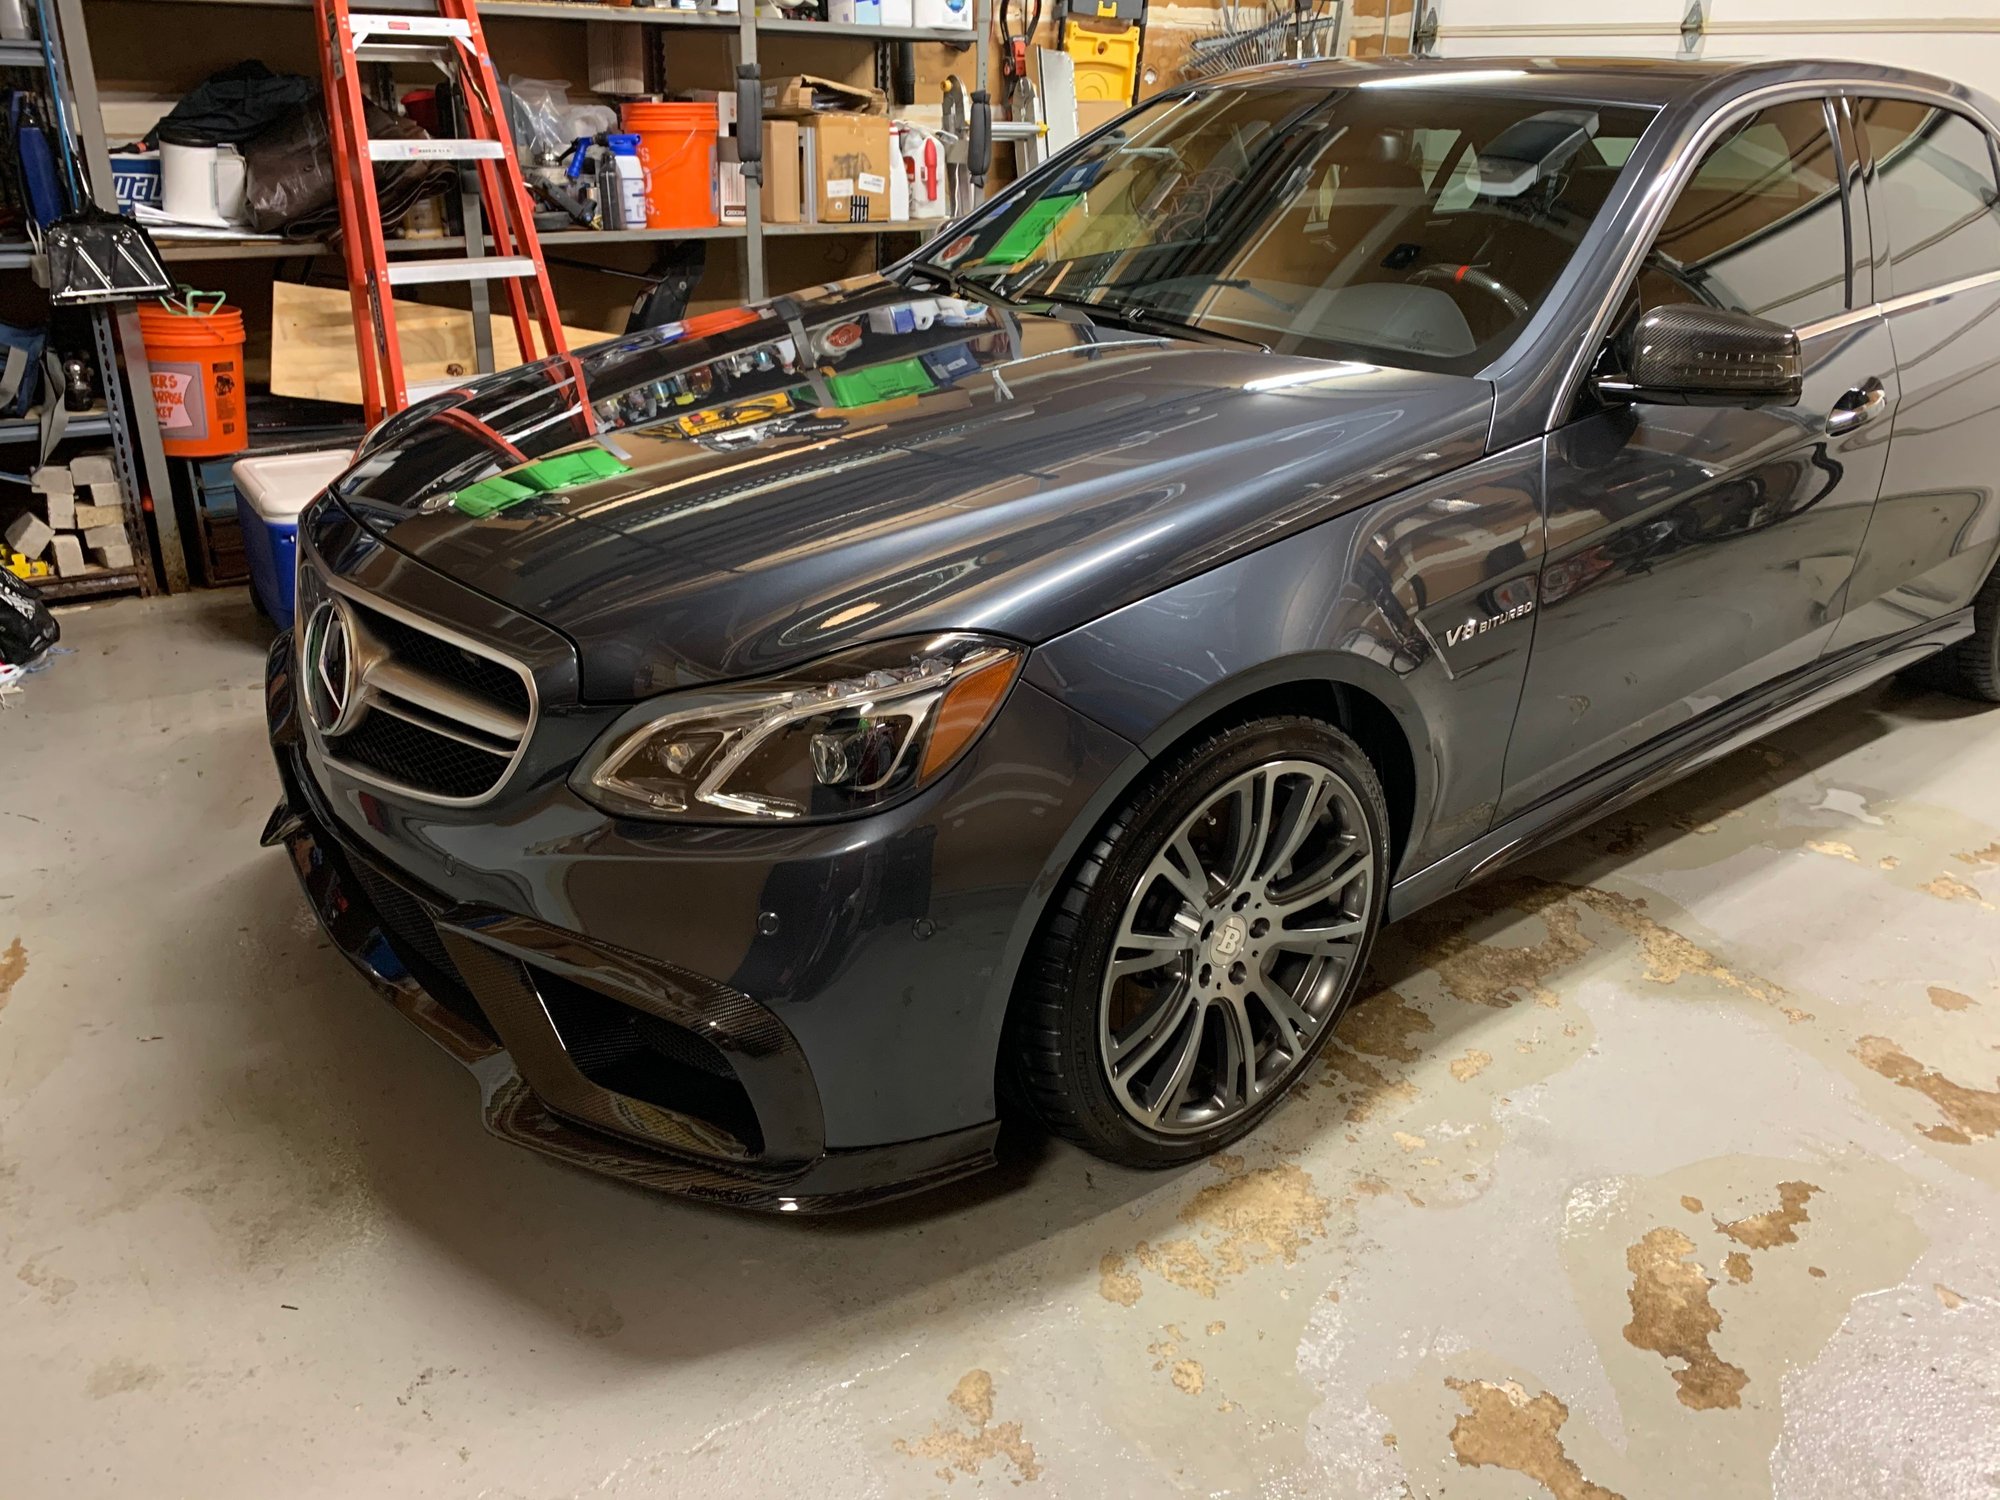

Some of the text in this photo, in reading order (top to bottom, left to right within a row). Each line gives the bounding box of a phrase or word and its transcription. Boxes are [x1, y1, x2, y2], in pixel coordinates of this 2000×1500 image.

[1446, 601, 1533, 648] V8 BITURBO
[1216, 925, 1241, 955] B
